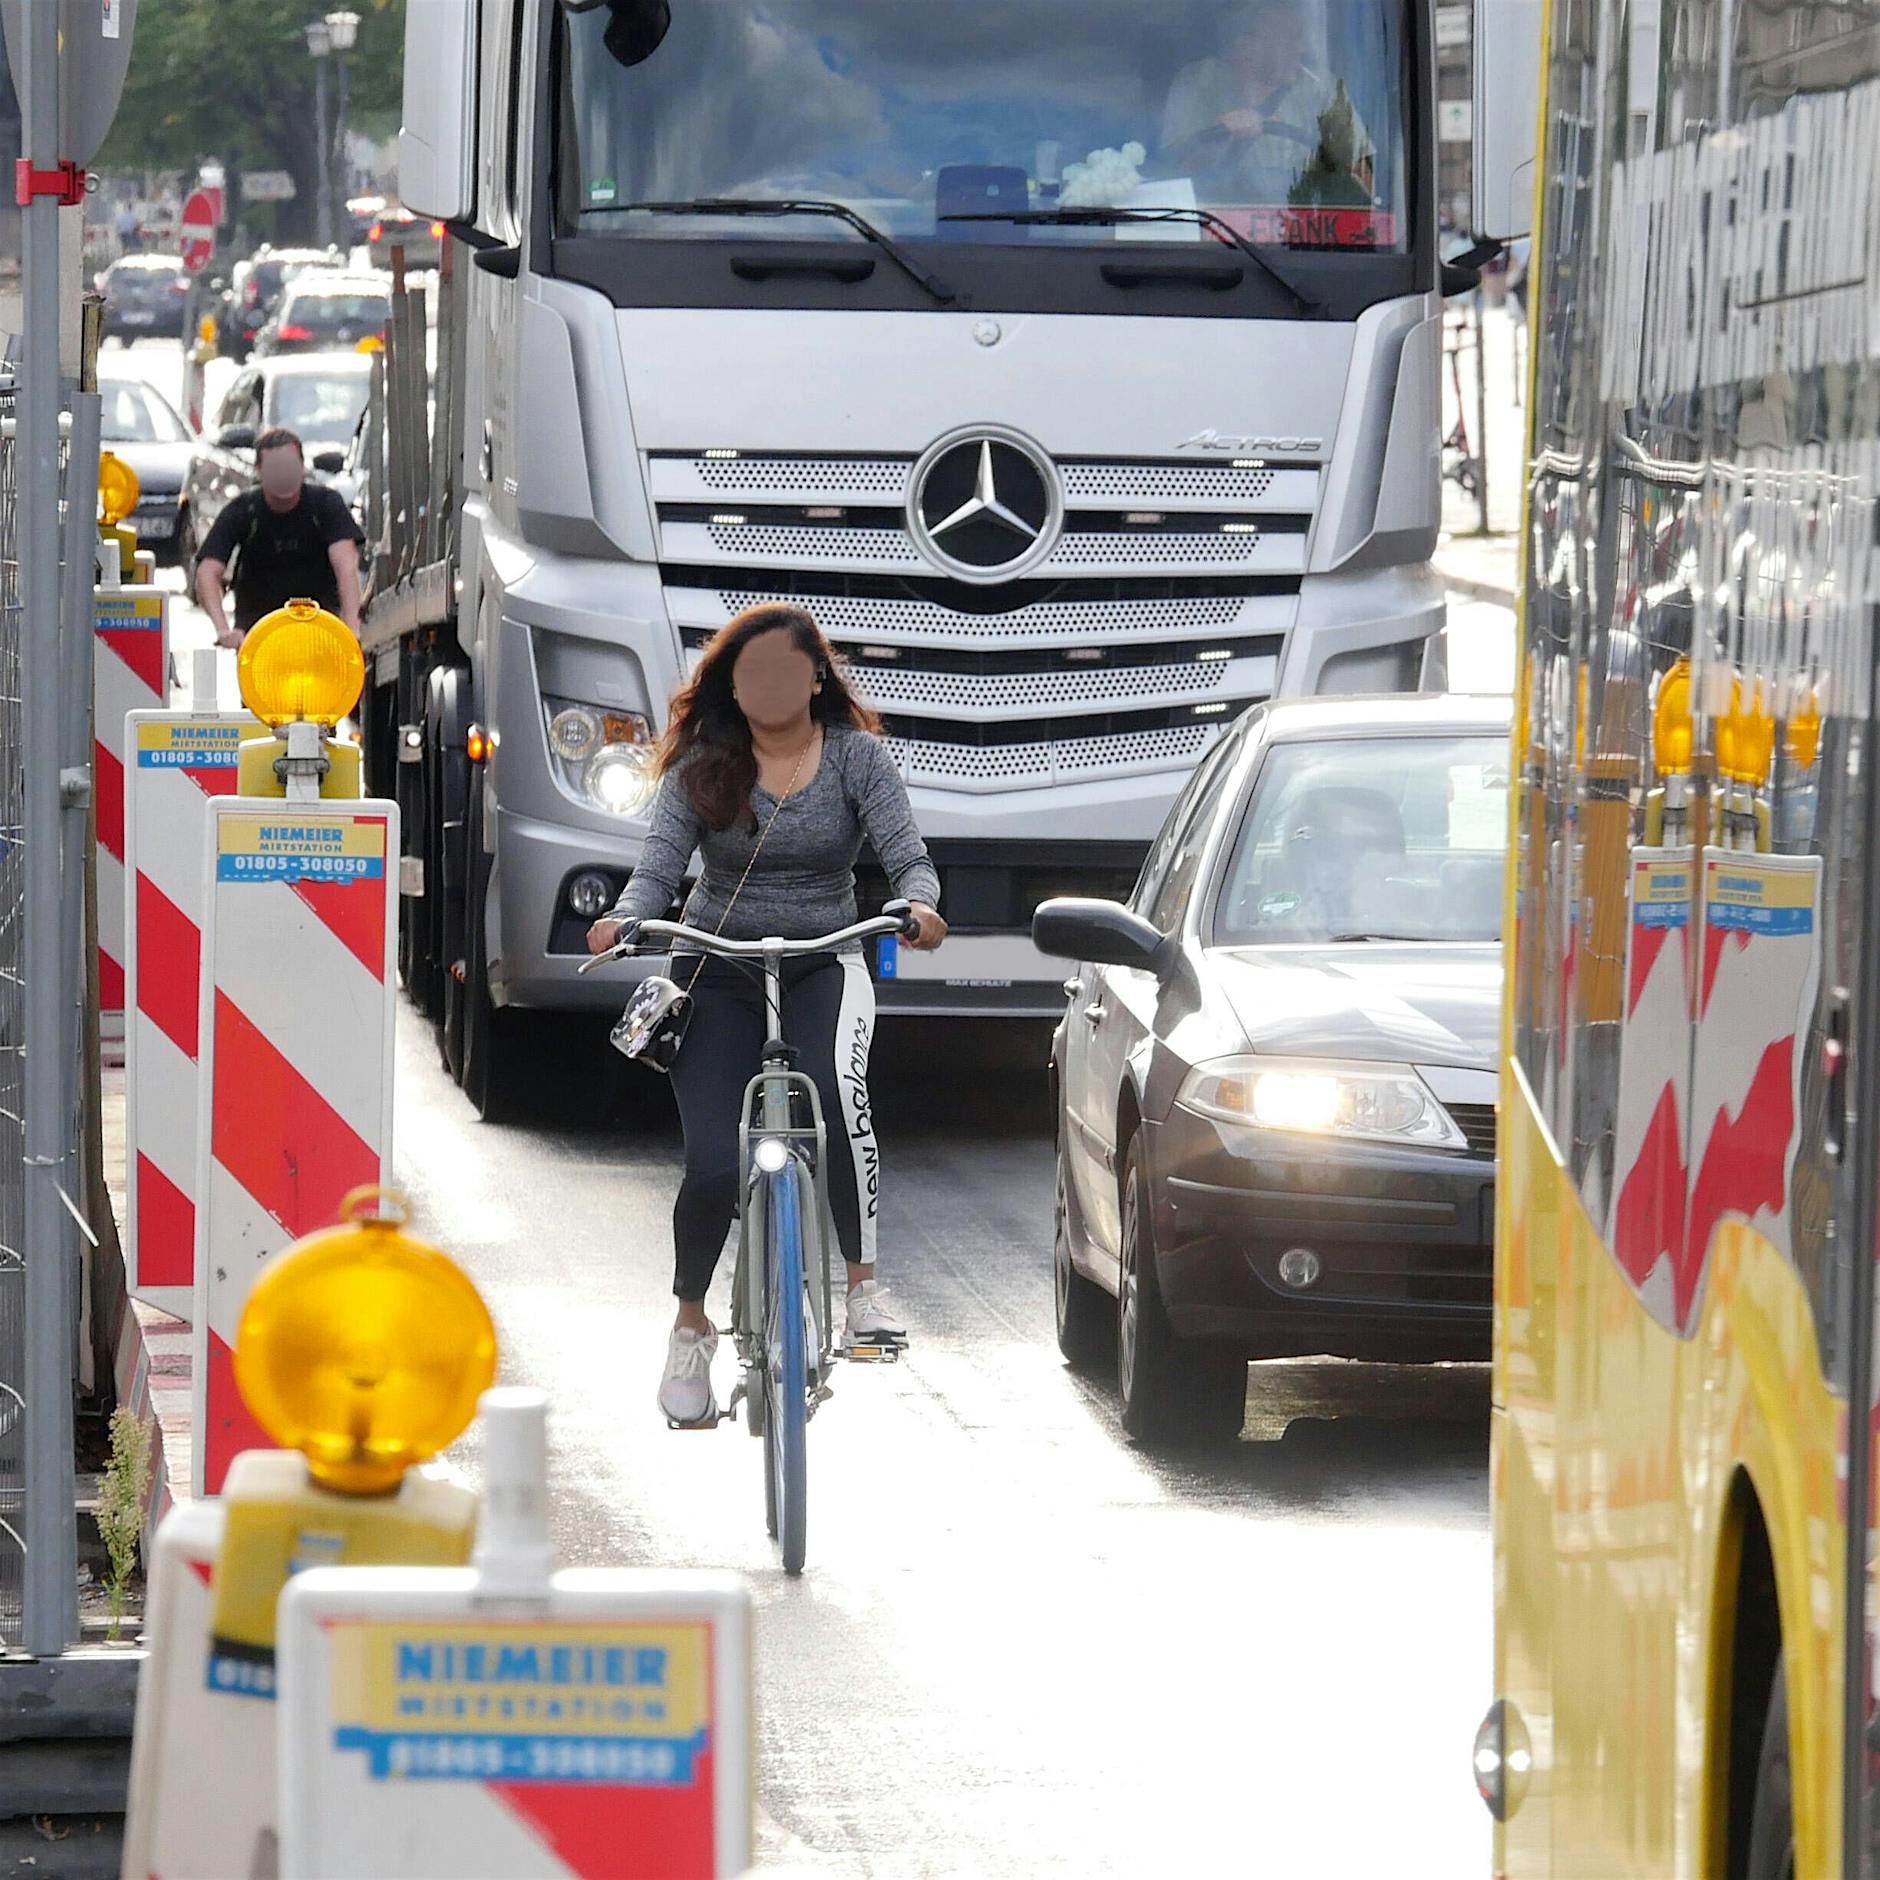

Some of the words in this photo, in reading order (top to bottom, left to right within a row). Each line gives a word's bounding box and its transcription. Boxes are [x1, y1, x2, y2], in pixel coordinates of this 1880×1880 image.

[1251, 214, 1338, 244] FRANK
[1176, 428, 1324, 452] ACTROS
[171, 727, 240, 739] NIEMEIER
[151, 751, 240, 764] 01805-3080
[259, 826, 343, 842] NIEMEIER
[259, 842, 343, 853] MIETSTATION
[234, 855, 368, 873] 01805-308050
[883, 960, 893, 972] D
[843, 1016, 873, 1140] balance
[862, 1145, 879, 1220] new
[396, 1642, 667, 1686] NIEMEIER
[397, 1697, 668, 1721] MIETSTATION
